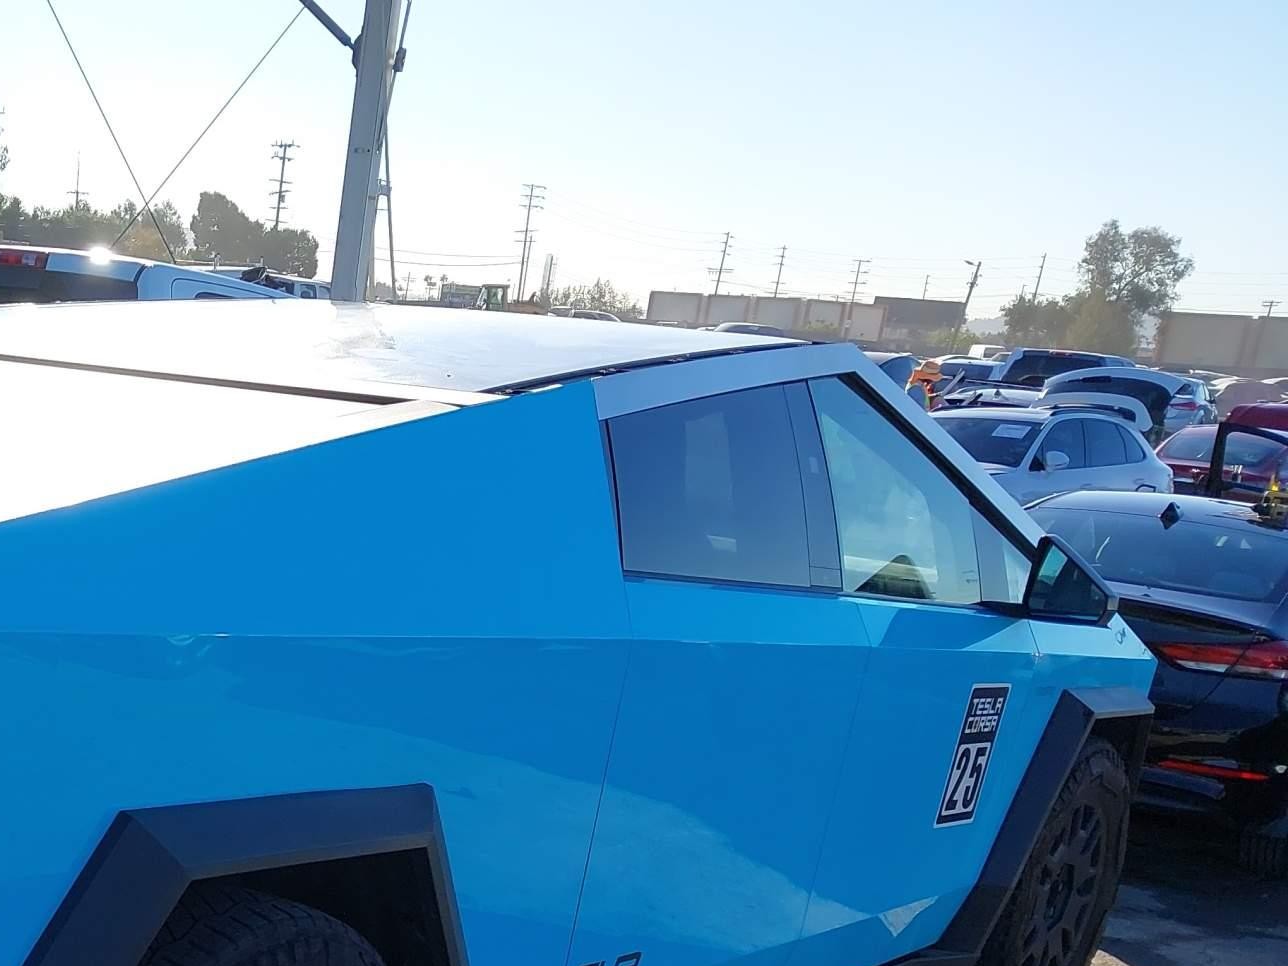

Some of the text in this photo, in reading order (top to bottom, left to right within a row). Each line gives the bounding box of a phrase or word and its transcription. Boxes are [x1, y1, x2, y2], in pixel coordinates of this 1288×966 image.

[970, 697, 1005, 715] TESLA
[964, 715, 999, 734] CORSA
[945, 746, 988, 811] 25
